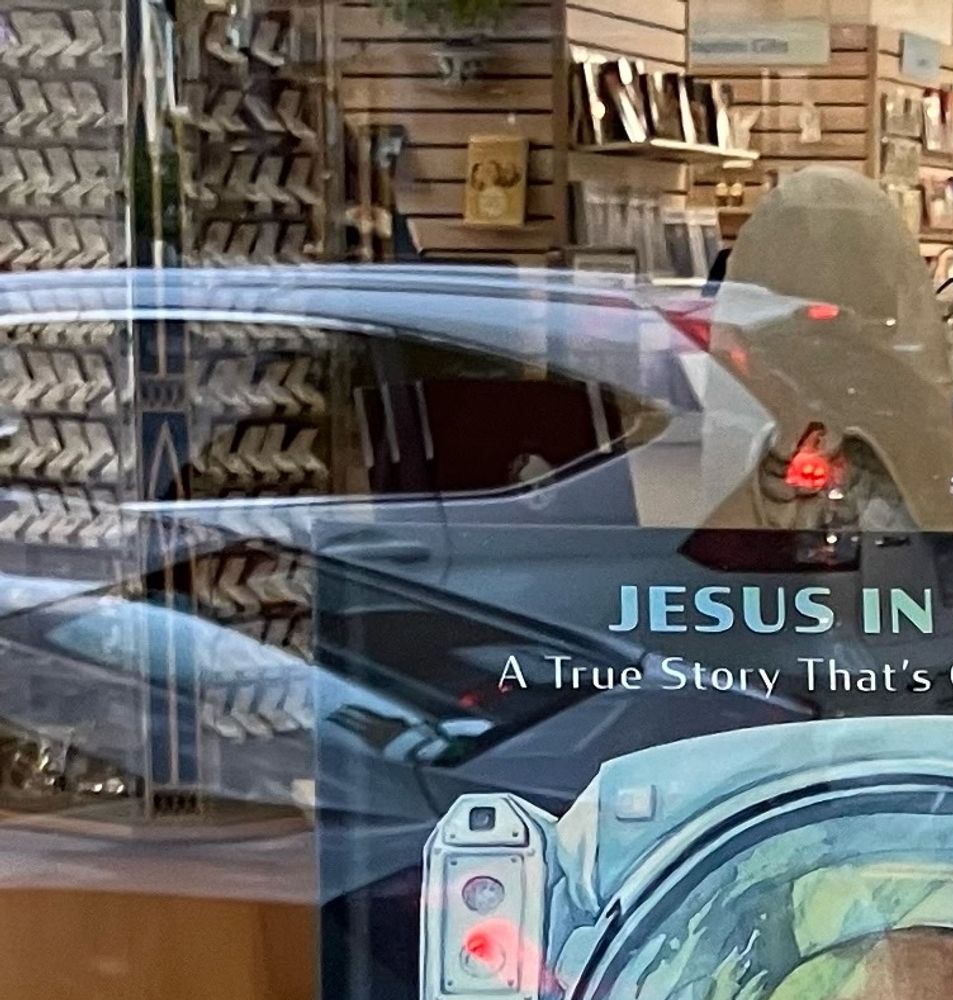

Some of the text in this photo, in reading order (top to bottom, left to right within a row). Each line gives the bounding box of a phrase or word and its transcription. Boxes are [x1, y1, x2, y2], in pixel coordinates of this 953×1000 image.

[609, 585, 834, 633] JESUS
[862, 587, 933, 634] IN
[499, 655, 527, 689] A
[544, 655, 642, 690] True
[661, 656, 781, 698] Story
[798, 657, 931, 692] That's
